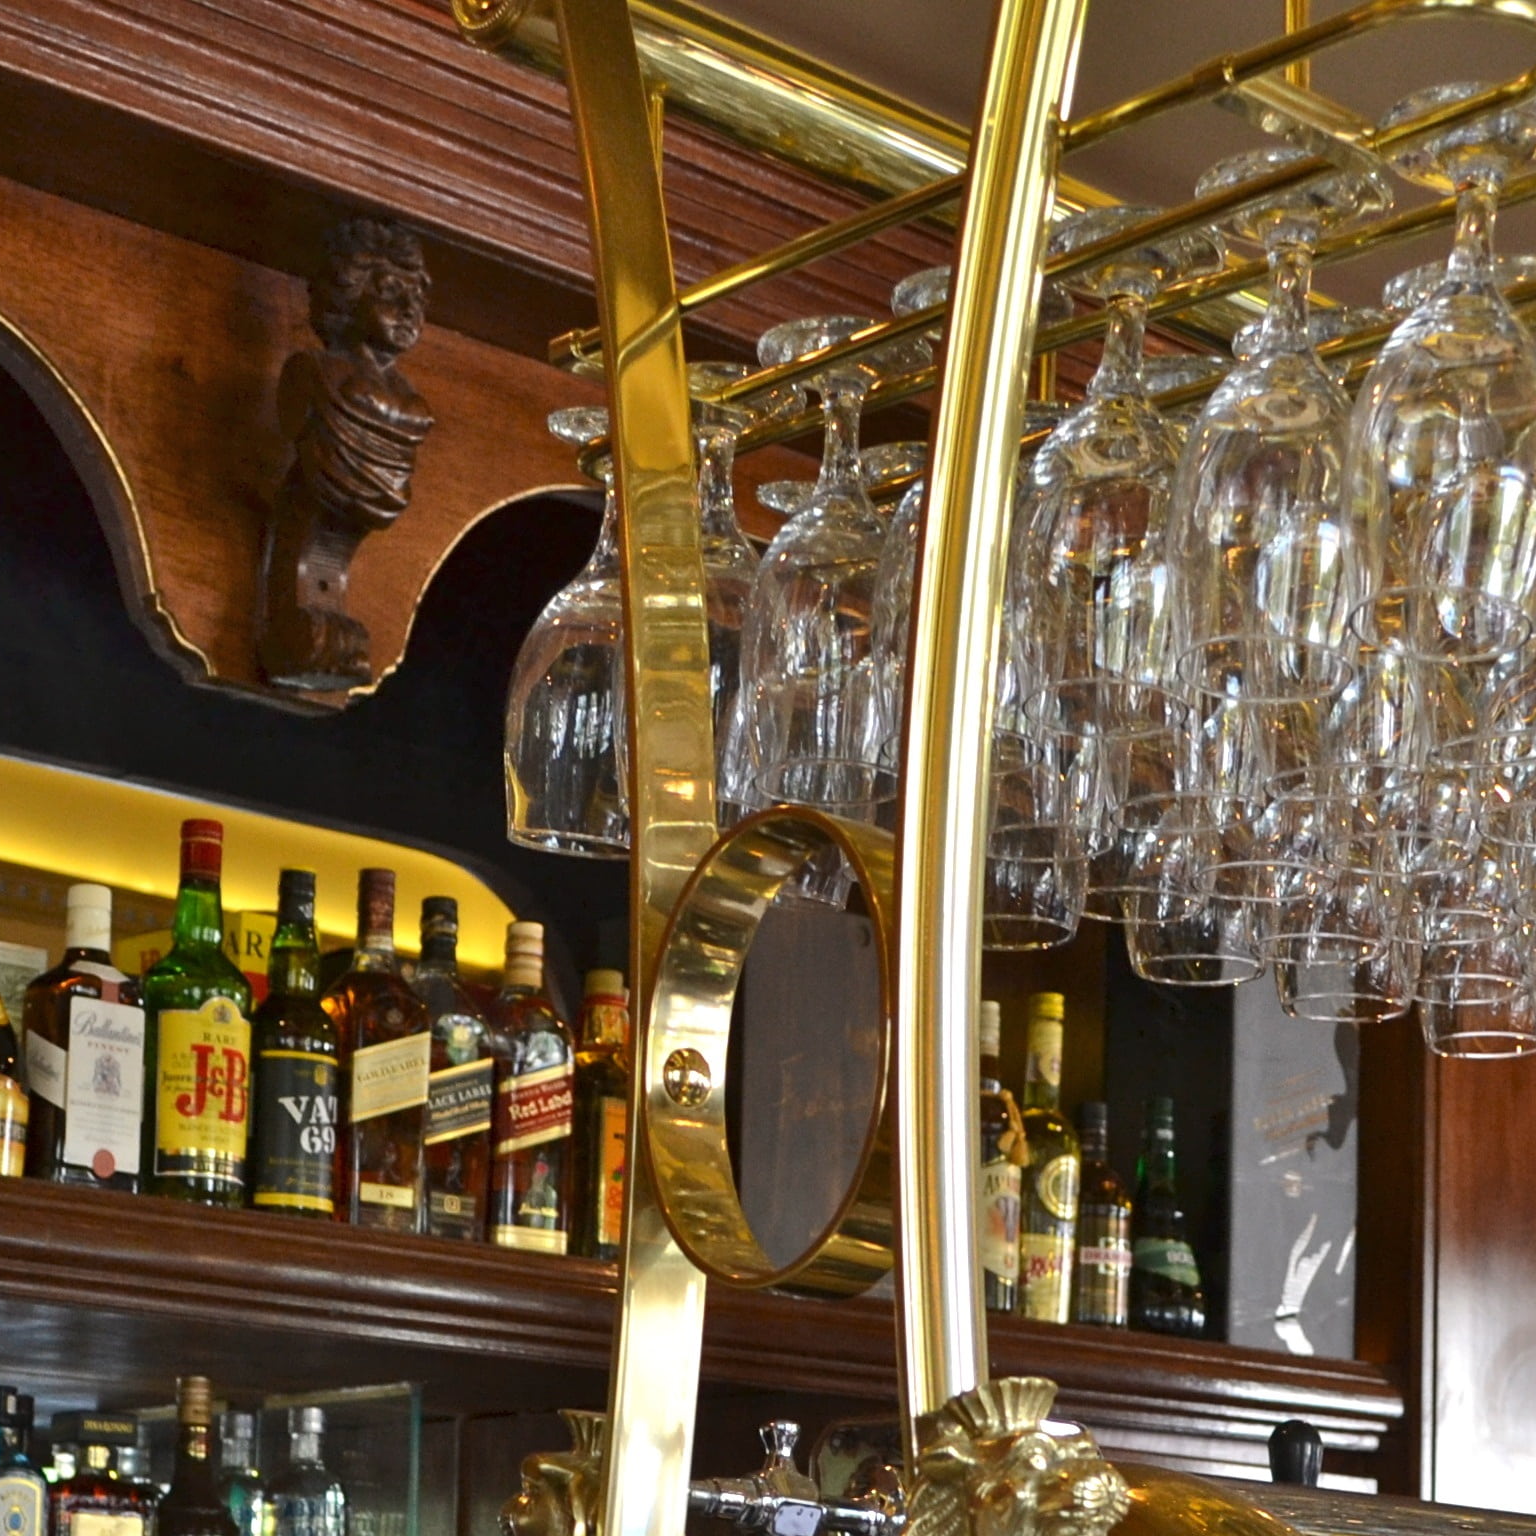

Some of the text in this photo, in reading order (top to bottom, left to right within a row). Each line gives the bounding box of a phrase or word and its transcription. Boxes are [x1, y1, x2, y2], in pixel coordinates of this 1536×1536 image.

[175, 1043, 248, 1123] J&B
[278, 1095, 338, 1124] VAT
[428, 1092, 456, 1110] LACK
[508, 1101, 538, 1121] Red
[300, 1126, 336, 1154] 69
